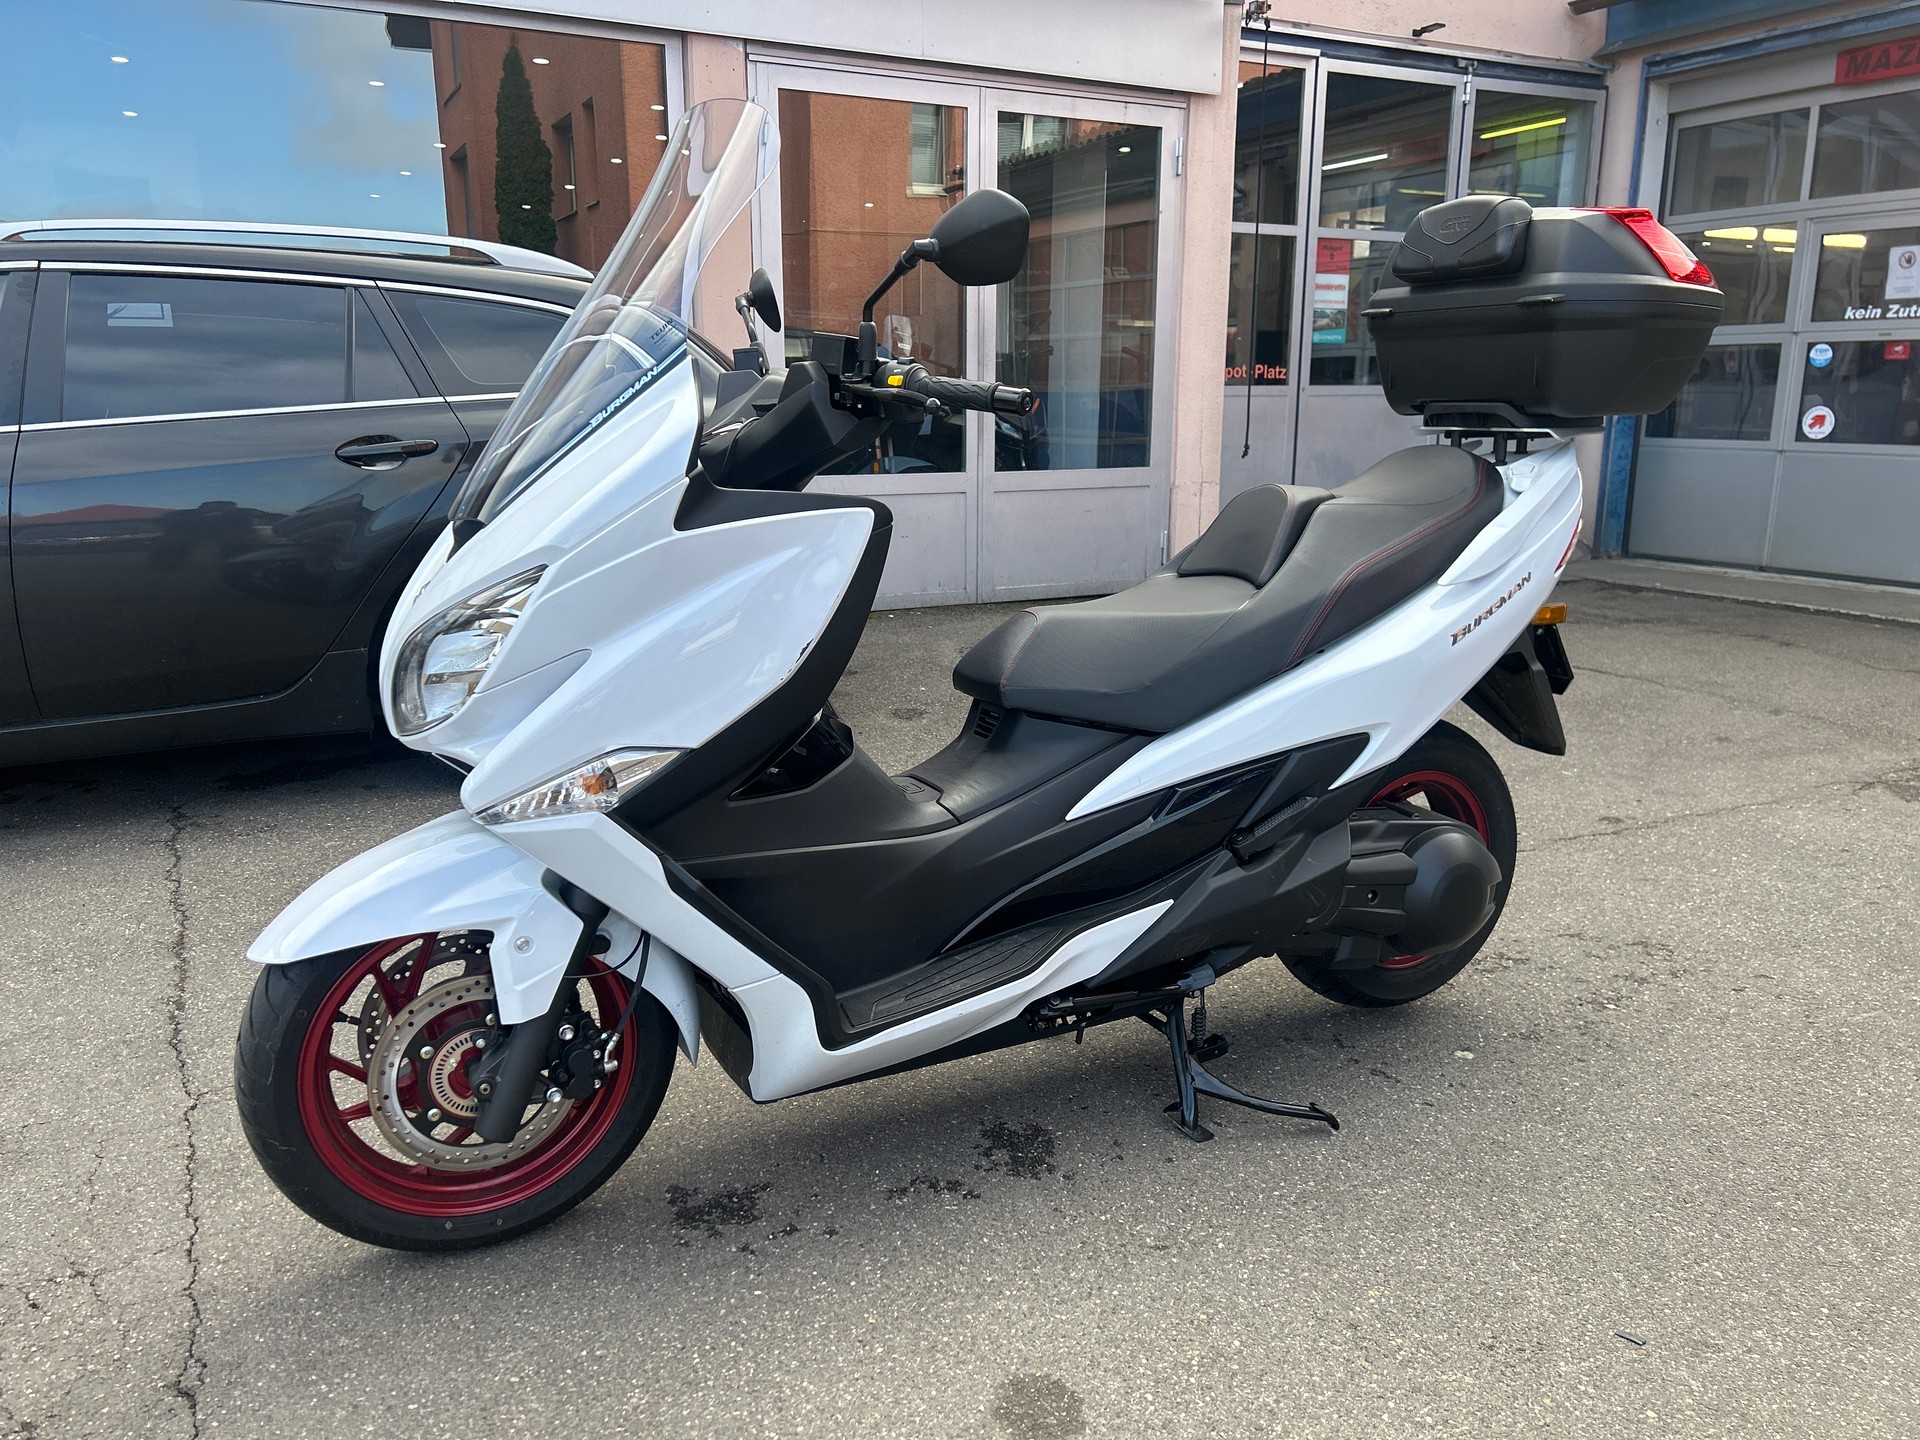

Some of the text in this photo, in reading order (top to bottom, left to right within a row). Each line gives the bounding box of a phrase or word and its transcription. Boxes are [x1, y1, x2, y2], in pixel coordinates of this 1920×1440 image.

[1844, 304, 1882, 320] kein
[1254, 364, 1287, 379] Platz
[589, 366, 658, 428] BURGMAN
[1450, 571, 1531, 647] BURGMAN
